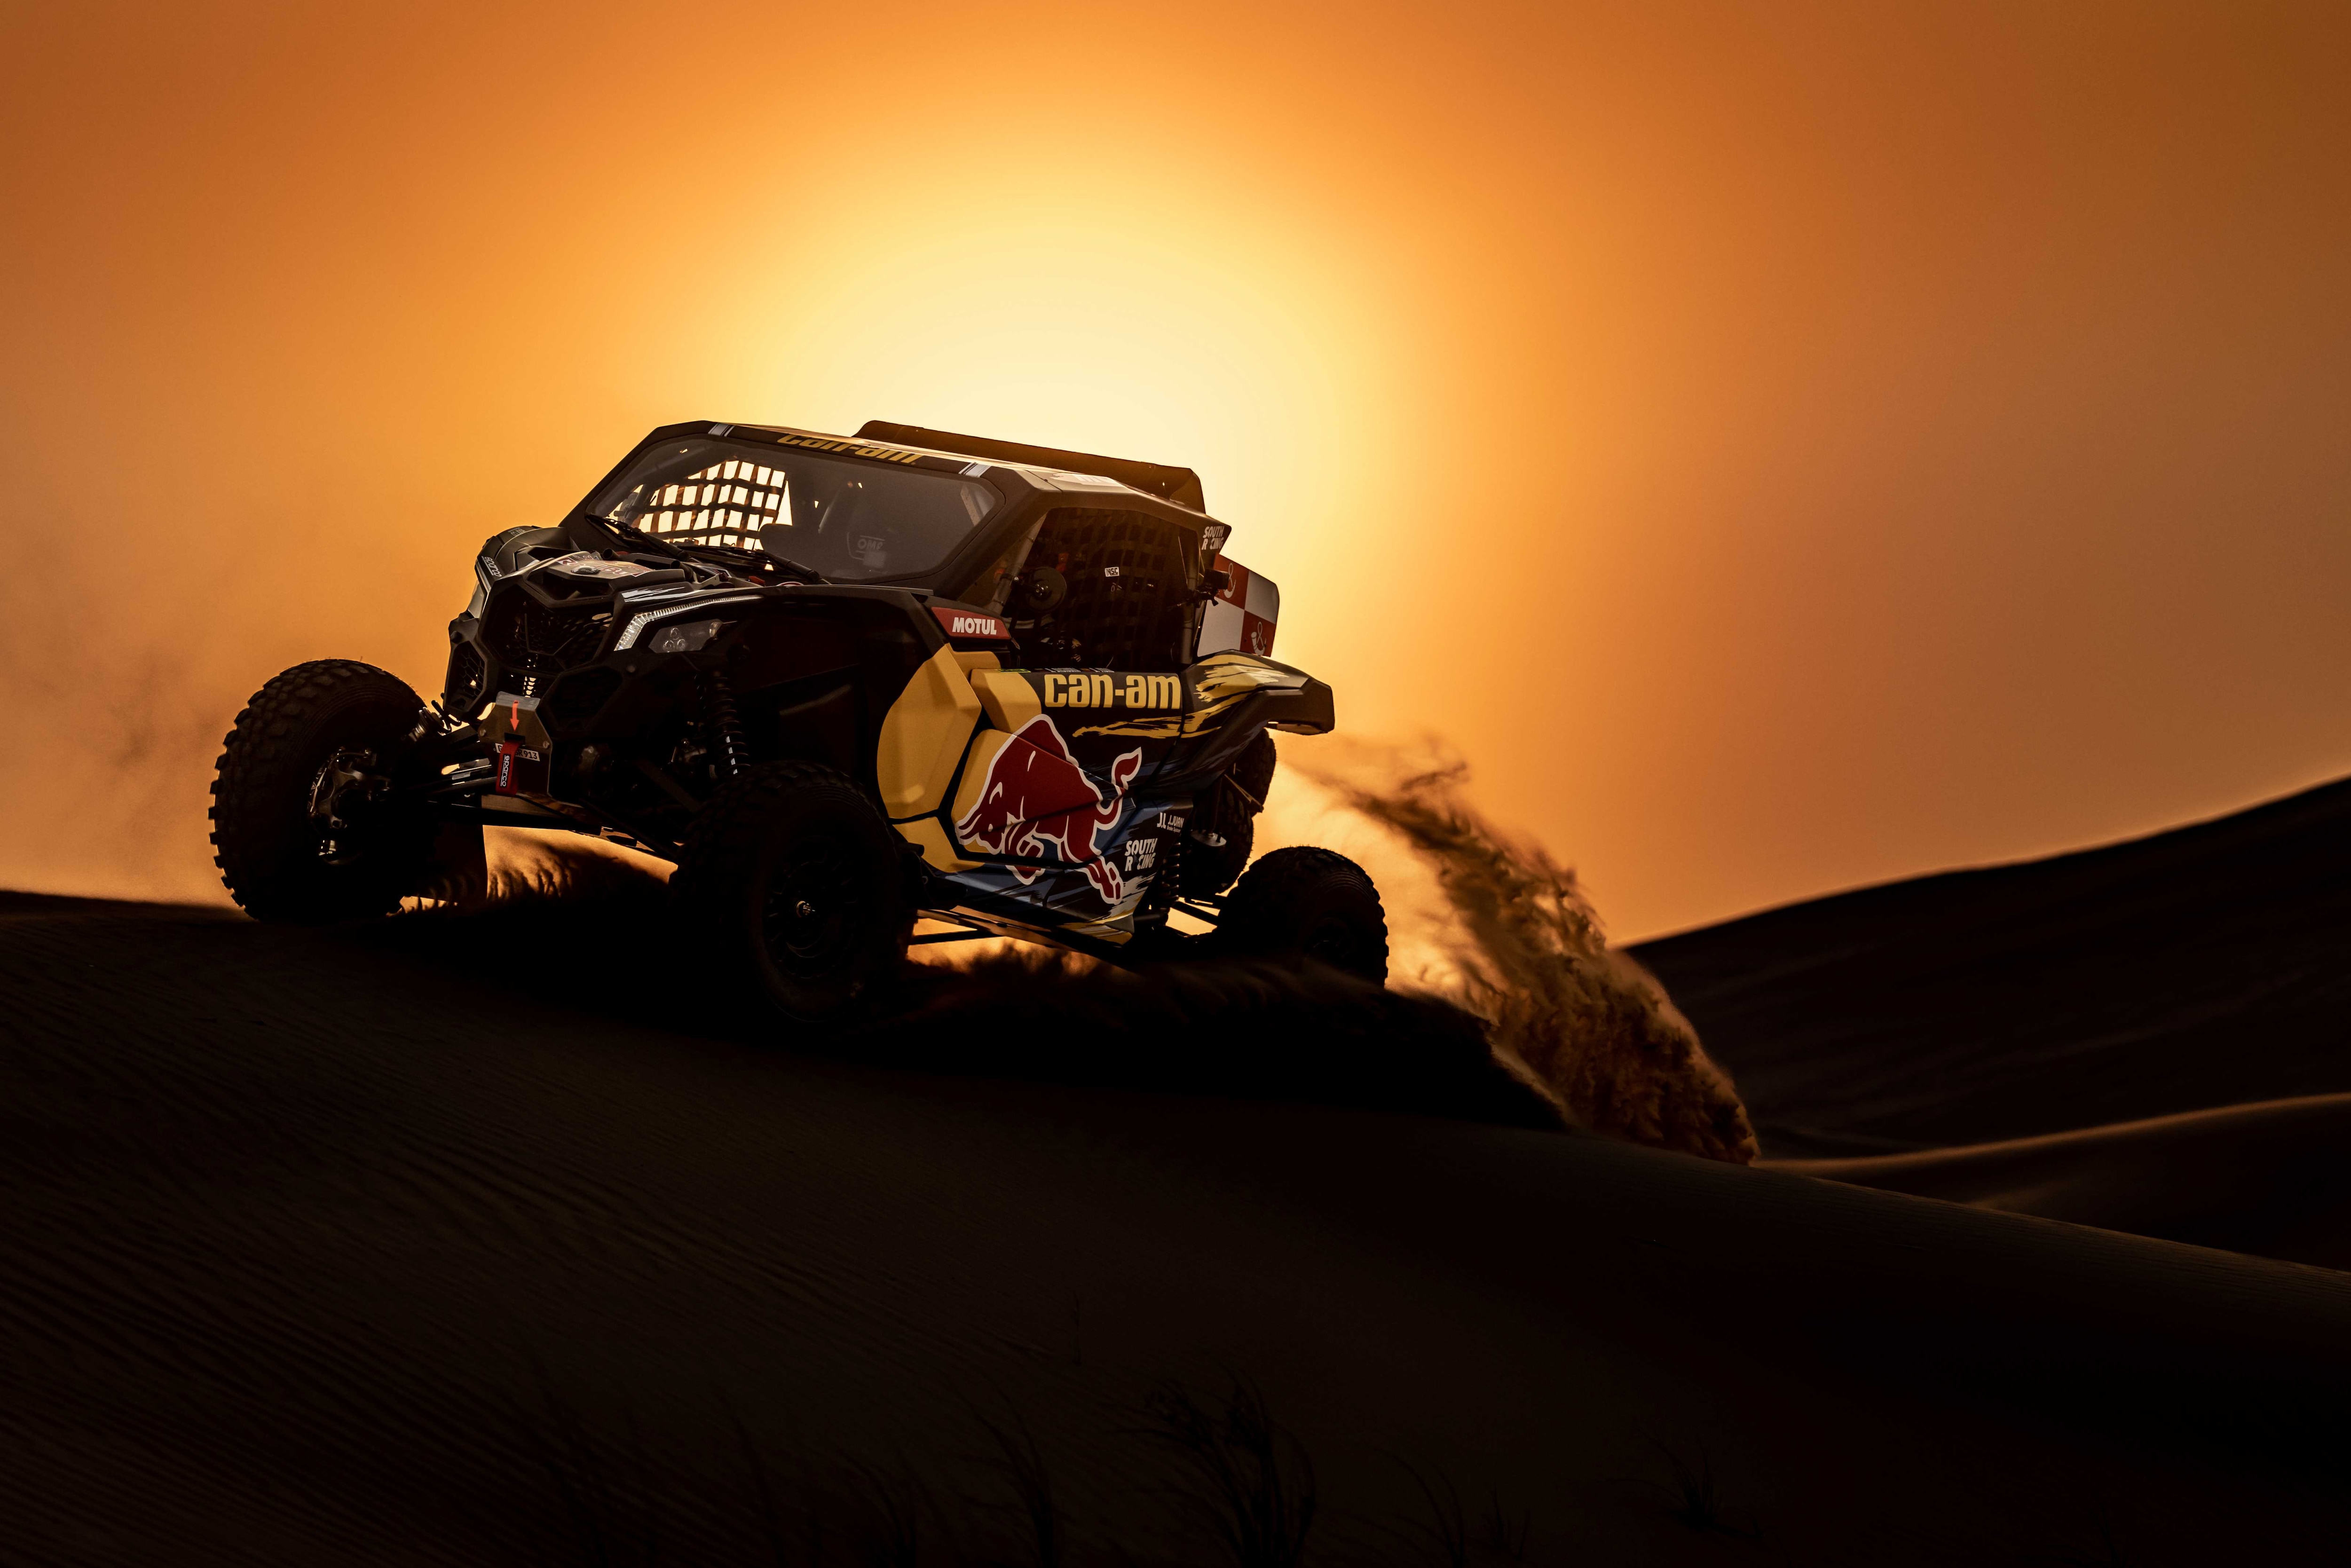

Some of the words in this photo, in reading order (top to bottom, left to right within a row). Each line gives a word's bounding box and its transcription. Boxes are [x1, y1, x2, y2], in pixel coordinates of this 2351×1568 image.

[1203, 526, 1224, 538] SOUTH
[952, 617, 997, 635] MOTUL
[1044, 674, 1181, 709] can-am
[523, 750, 537, 760] 913
[1168, 815, 1184, 828] J.JUAN
[1125, 838, 1158, 856] SOUTH
